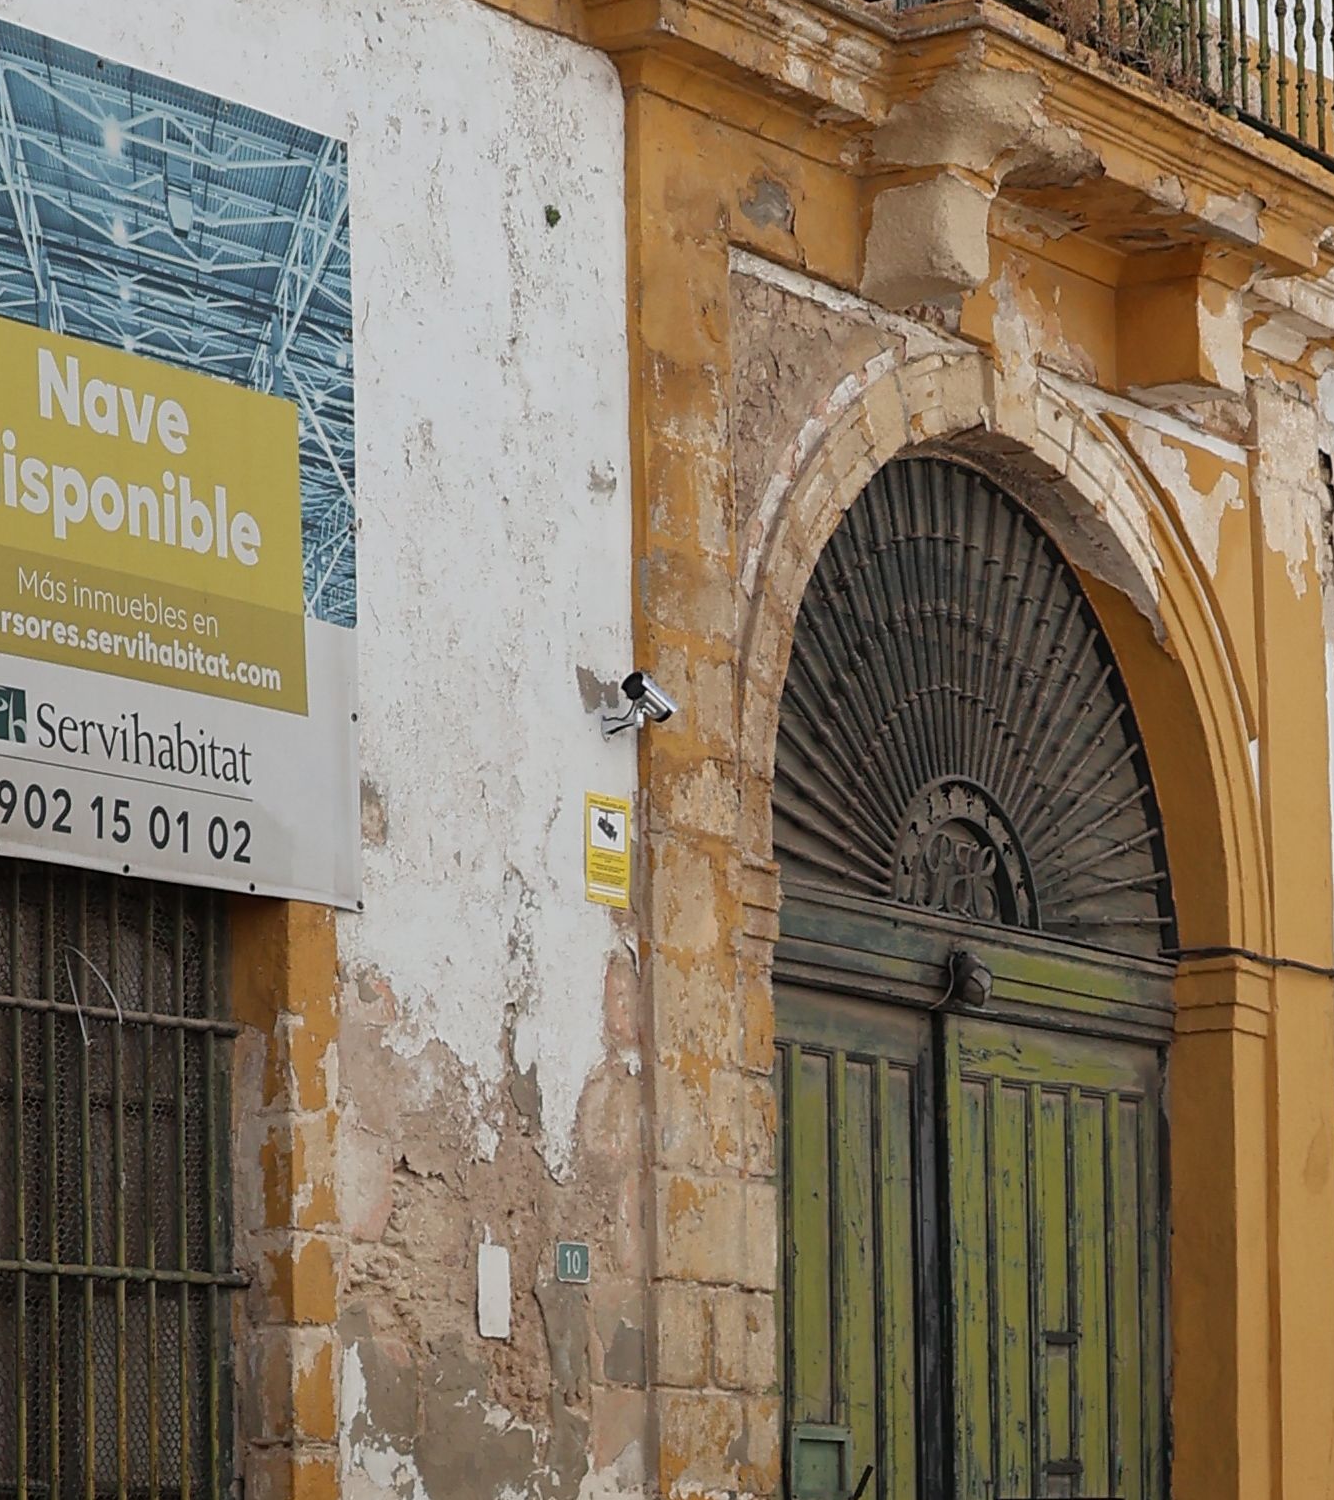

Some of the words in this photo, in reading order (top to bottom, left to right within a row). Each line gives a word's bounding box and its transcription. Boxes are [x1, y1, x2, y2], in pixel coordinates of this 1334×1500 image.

[38, 347, 190, 455] Nave
[17, 566, 67, 605] Más
[73, 578, 188, 631] inmuebles
[192, 611, 219, 638] en
[36, 702, 253, 786] Servihabitat
[89, 795, 132, 844] 15
[148, 805, 189, 854] 01
[207, 815, 252, 864] 02
[565, 1250, 581, 1274] 10
